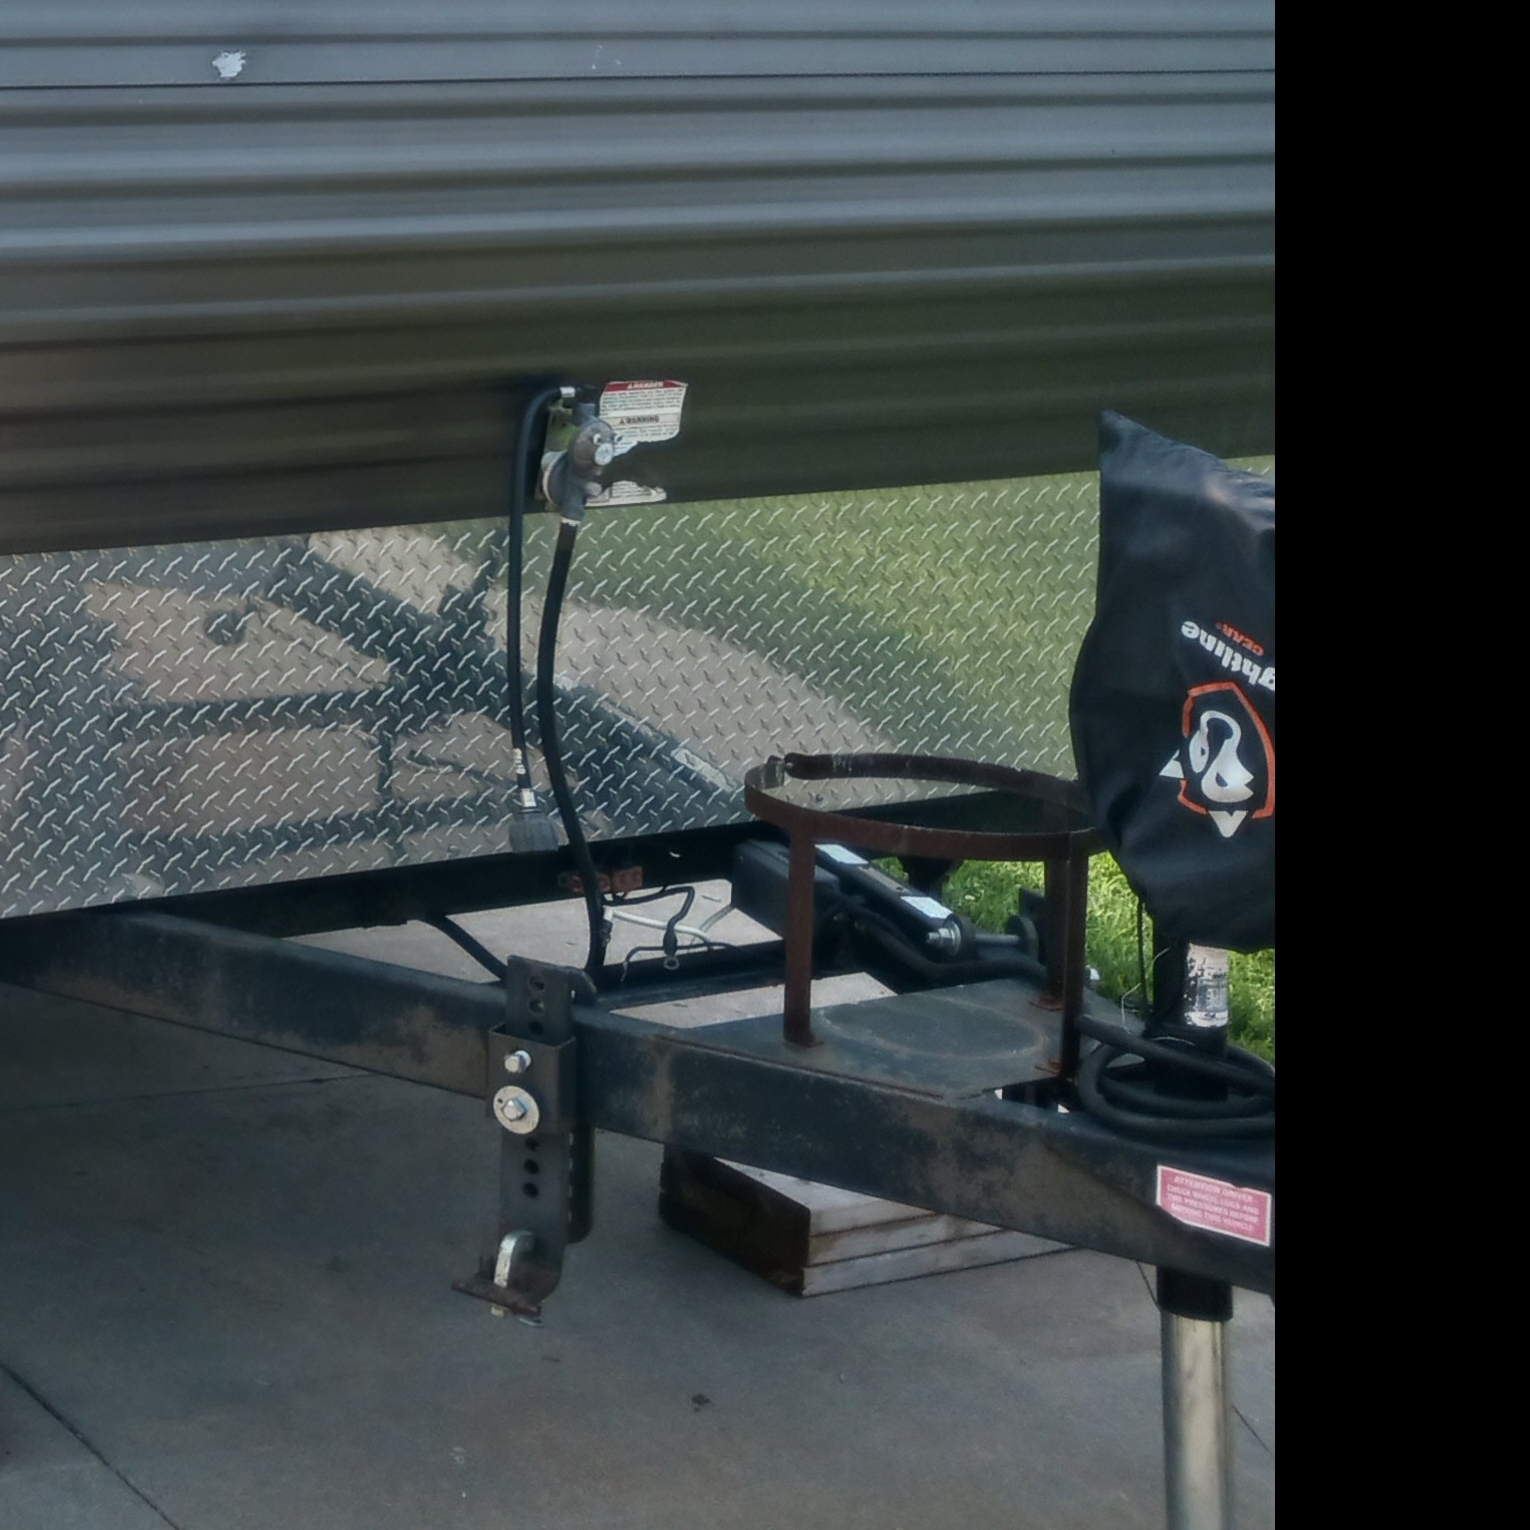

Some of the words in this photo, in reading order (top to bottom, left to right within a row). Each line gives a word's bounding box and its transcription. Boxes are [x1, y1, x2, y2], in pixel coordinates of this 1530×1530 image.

[1173, 1176, 1221, 1193] ATTENTION
[1222, 1187, 1254, 1202] DRIVER
[1242, 1204, 1259, 1215] AND
